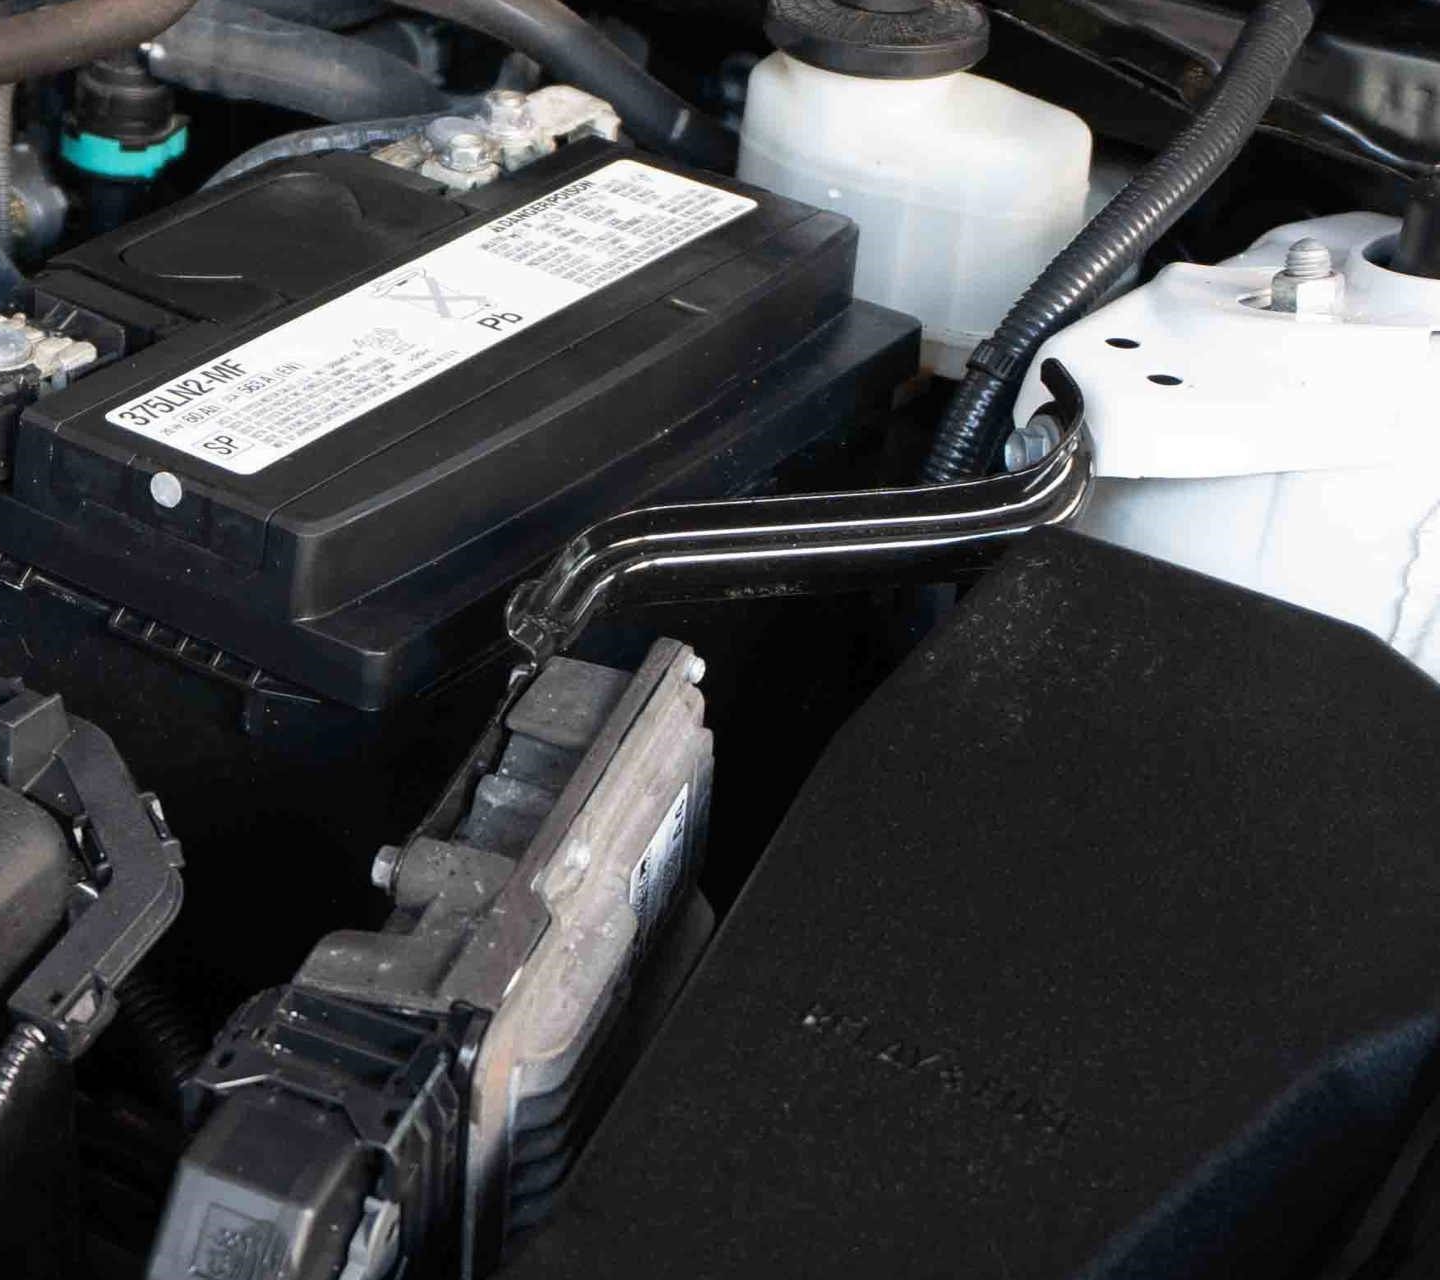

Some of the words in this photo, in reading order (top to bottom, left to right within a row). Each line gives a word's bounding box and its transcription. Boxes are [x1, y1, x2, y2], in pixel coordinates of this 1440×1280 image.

[501, 179, 595, 227] DANGER/POISON
[477, 311, 523, 331] Pb
[119, 358, 247, 426] 375LN2-MF
[203, 434, 240, 456] SP
